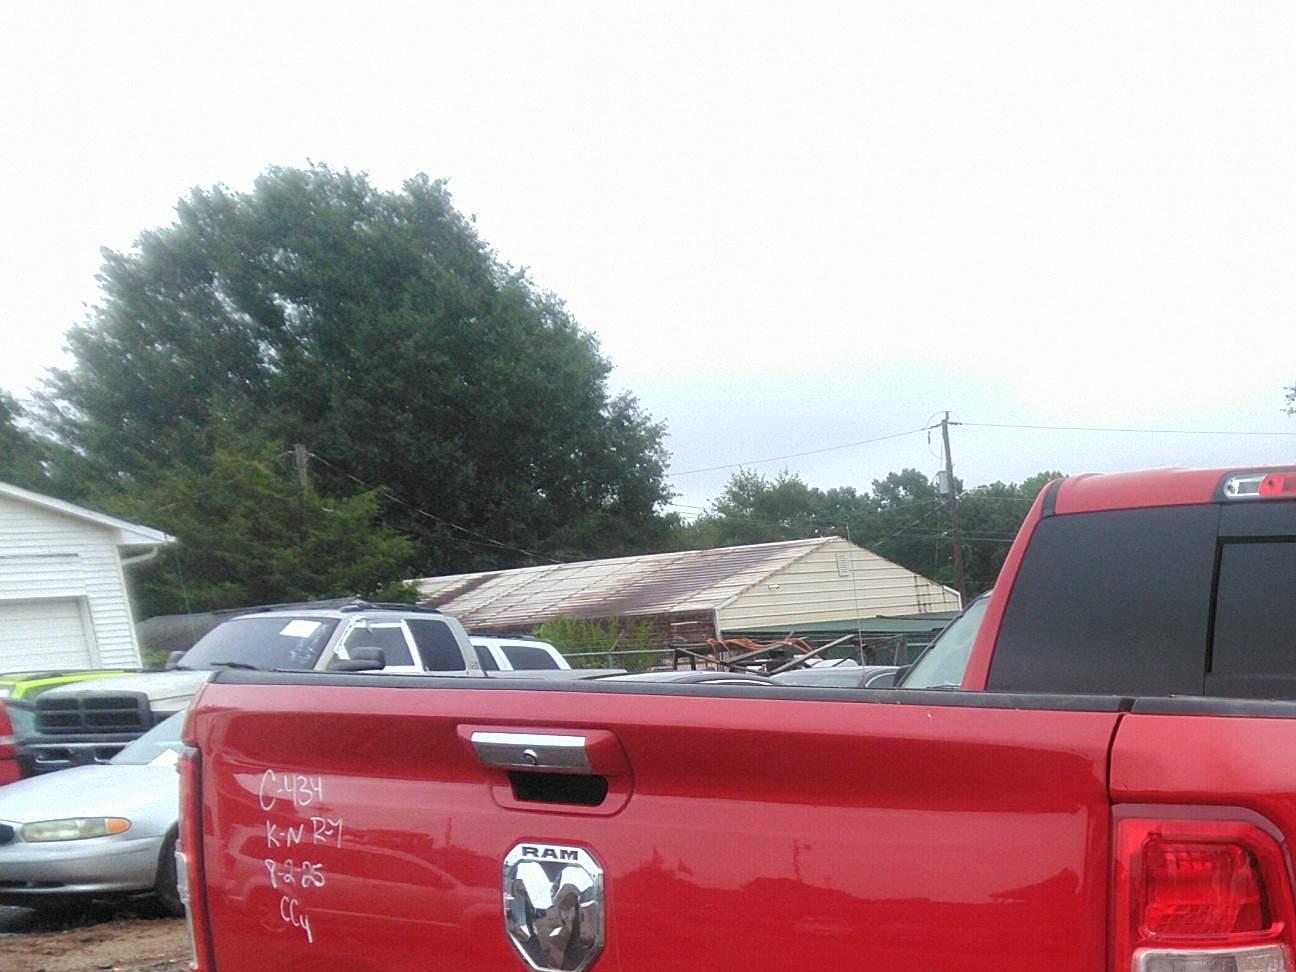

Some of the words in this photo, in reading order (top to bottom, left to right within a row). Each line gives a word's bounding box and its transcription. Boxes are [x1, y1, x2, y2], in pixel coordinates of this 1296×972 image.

[259, 769, 323, 811] C-434
[266, 820, 304, 848] K-N
[521, 846, 579, 861] RAM
